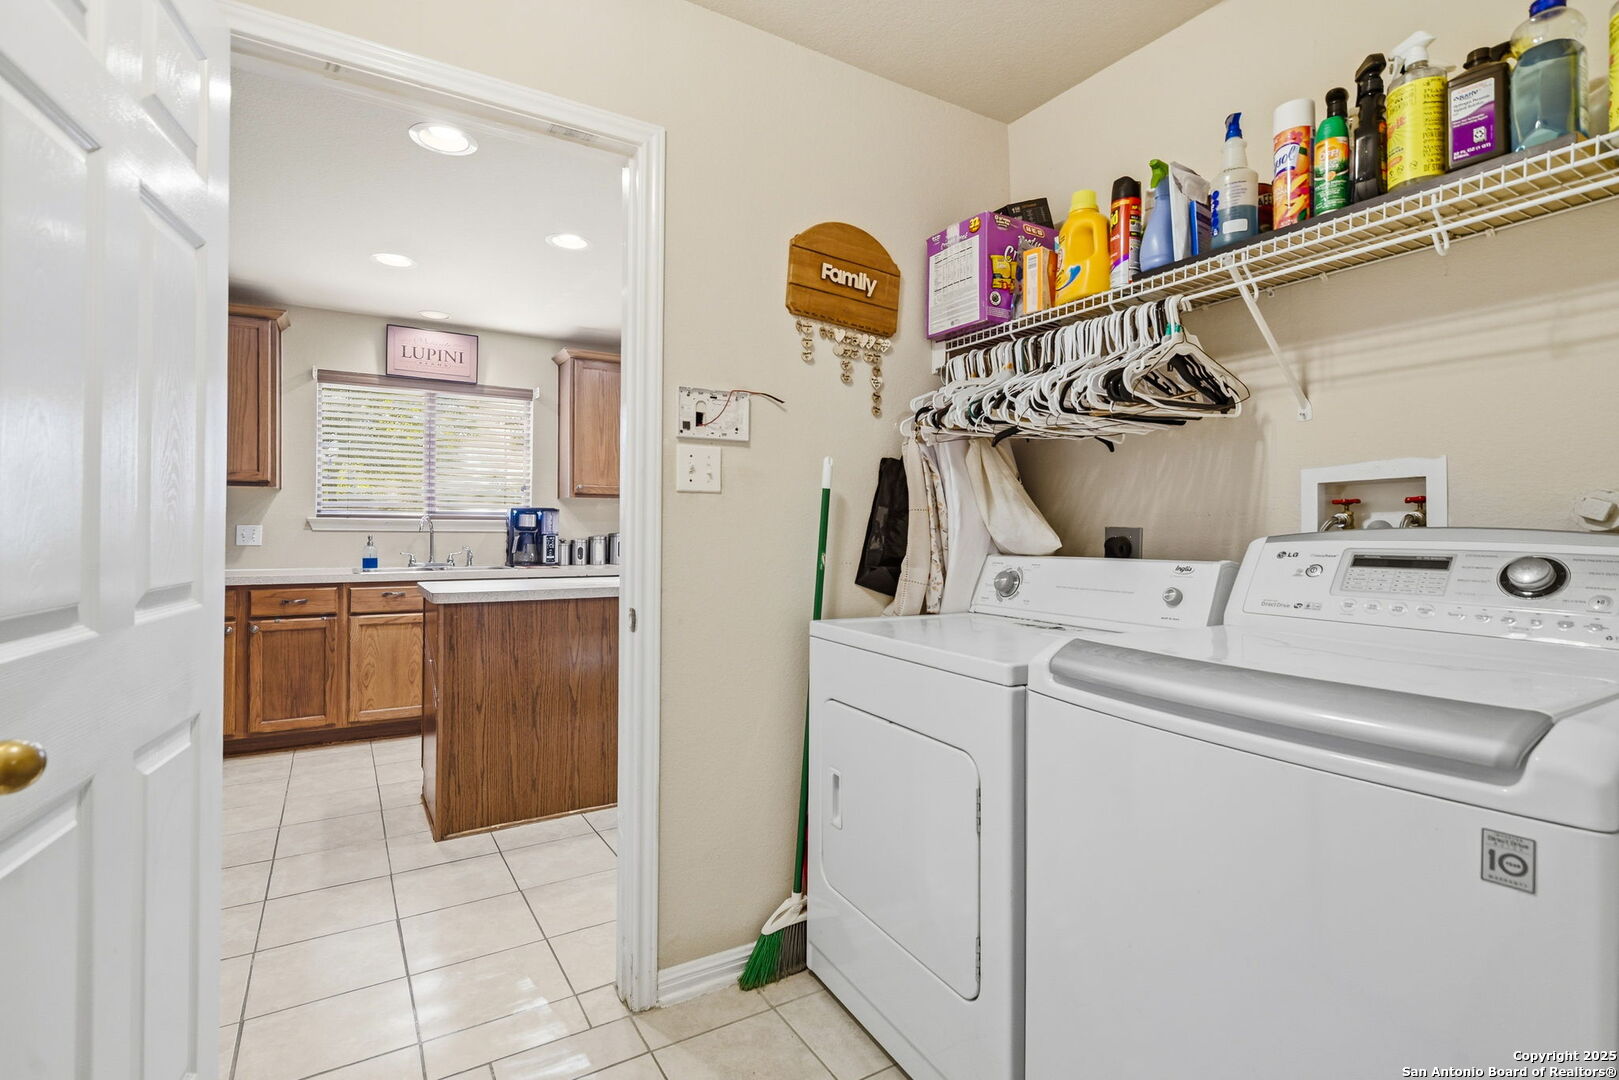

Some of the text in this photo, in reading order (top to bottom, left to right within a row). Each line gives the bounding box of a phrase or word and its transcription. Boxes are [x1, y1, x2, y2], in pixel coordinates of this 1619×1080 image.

[1275, 145, 1297, 168] sol
[1110, 209, 1119, 228] id
[820, 262, 878, 297] Family
[401, 345, 464, 364] LUPINI
[1488, 849, 1529, 877] 10
